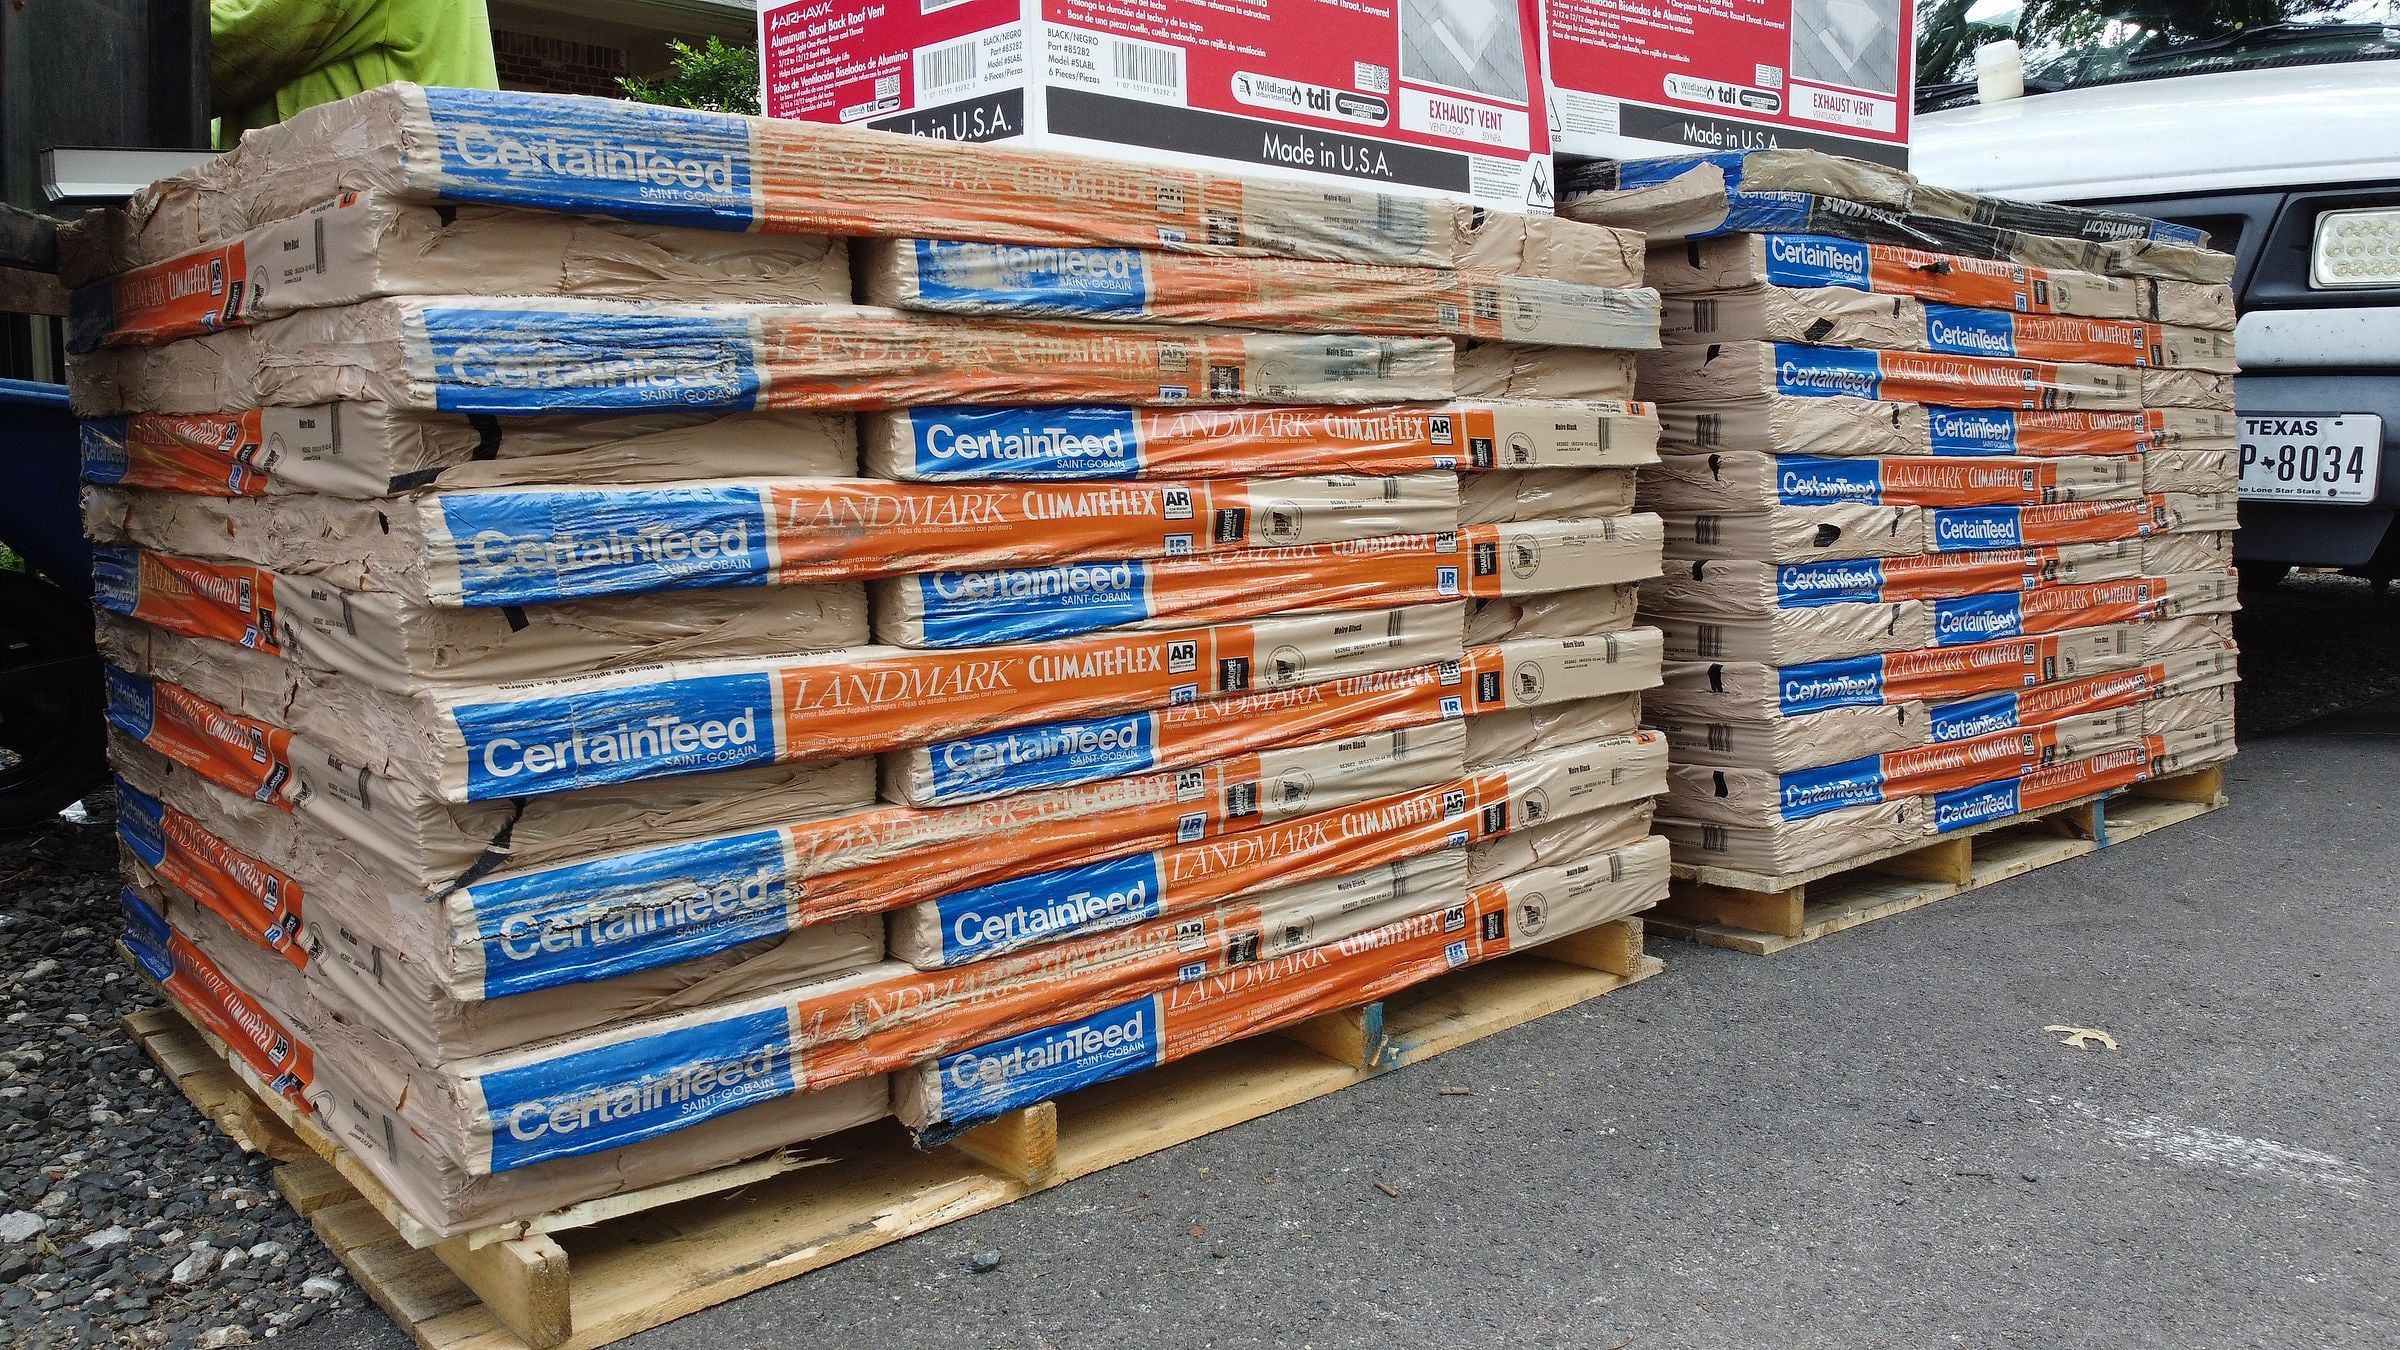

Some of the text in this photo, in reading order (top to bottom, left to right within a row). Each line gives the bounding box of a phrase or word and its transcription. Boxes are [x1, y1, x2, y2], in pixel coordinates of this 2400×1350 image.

[778, 1, 833, 28] AIRHAWK
[1098, 2, 1105, 10] la
[1106, 3, 1134, 17] duración
[1135, 8, 1146, 19] del
[1147, 11, 1164, 24] techo
[1170, 16, 1178, 26] de
[1362, 3, 1390, 18] Louvered
[1619, 1, 1693, 25] Biselados de Aluminio
[1730, 11, 1745, 21] Round
[1746, 13, 1763, 26] Throat,
[771, 4, 885, 48] Aluminum Slant Back Roof Vent
[1067, 9, 1083, 20] Base
[1085, 12, 1093, 23] de
[1095, 17, 1108, 26] una
[1152, 28, 1169, 39] cuello
[1171, 32, 1198, 45] redondo,
[1199, 38, 1209, 46] con
[1228, 42, 1236, 51] de
[983, 28, 1022, 47] BLACK/NEGRO
[1047, 28, 1099, 46] BLACK/NEGRO
[990, 47, 1001, 57] Part
[1047, 41, 1090, 57] Part #85282
[773, 83, 790, 94] Tubos
[791, 79, 800, 89] de
[800, 70, 834, 87] Ventilación
[836, 64, 866, 80] Biselados
[867, 57, 876, 68] de
[878, 51, 908, 67] Aluminio
[987, 58, 1003, 69] Model
[1048, 54, 1095, 71] Model #SLABL
[989, 67, 1023, 81] Pieces/Piezas
[1055, 69, 1100, 84] Pieces/Piezas
[1255, 80, 1292, 96] Wildland
[1680, 81, 1707, 94] Wildland
[1718, 86, 1736, 104] tdi
[866, 102, 876, 113] tdi
[1306, 87, 1331, 111] tdi
[1813, 93, 1875, 118] EXHAUST VENT
[953, 102, 1012, 141] U.S.A.
[1430, 100, 1502, 131] EXHAUST VENT
[1430, 122, 1464, 135] VENTILADOR
[1482, 132, 1490, 141] 50
[1683, 122, 1738, 148] Made in
[454, 121, 733, 194] CertainTeed
[1263, 132, 1393, 177] Made in U.S.A.
[1771, 236, 1862, 273] CertainTeed
[212, 262, 222, 281] AR
[2014, 264, 2024, 276] AR
[1060, 279, 1132, 291] SAINT-GOBAIN
[2016, 297, 2025, 309] IR
[1932, 320, 2008, 352] CertainTeed
[2016, 318, 2132, 345] LANDMARK CLIMATEFLEX
[2133, 330, 2142, 341] AR
[1886, 357, 2021, 387] LANDMARK CLIMATEFLEX
[639, 385, 742, 403] SAINT-GOBAIN
[1150, 412, 1424, 442] LANDMARK CLIMATEFLEX
[1431, 419, 1450, 433] AR
[1934, 414, 2010, 442] CertainTeed
[2245, 420, 2318, 436] TEXAS
[926, 424, 1124, 460] CertainTeed
[232, 466, 243, 482] IR
[1057, 459, 1125, 469] SAINT-GOBAIN
[2277, 444, 2364, 484] 8034
[1886, 465, 2021, 489] LANDMARK CLIMATEFLEX
[2023, 470, 2033, 482] AR
[1166, 491, 1189, 506] AR
[2238, 486, 2249, 494] he
[2251, 486, 2273, 494] Lone
[2296, 487, 2321, 495] State
[785, 489, 1157, 529] LANDMARK CLIMATEFLEX
[1223, 510, 1233, 541] SHAKOPEE
[1940, 517, 2015, 540] CertainTeed
[475, 520, 750, 568] CertainTeed
[656, 558, 751, 574] SAINT-GOBAIN
[1441, 571, 1456, 584] IR
[1061, 592, 1131, 607] SAINT-GOBAIN
[2024, 590, 2087, 612] LANDMARK
[1170, 643, 1194, 660] AR
[1887, 643, 2021, 676] LANDMARK CLIMATEFLEX
[2024, 645, 2034, 657] AR
[790, 645, 1161, 712] LANDMARK CLIMATEFLEX
[790, 711, 817, 720] Polymer
[871, 702, 897, 712] Shingles
[901, 701, 917, 710] Tejas
[1444, 701, 1458, 713] IR
[484, 707, 756, 778] CertainTeed
[944, 719, 1138, 772] CertainTeed
[2023, 734, 2033, 748] AR
[664, 743, 757, 768] SAINT-GOBAIN
[1887, 736, 2021, 779] LANDMARK CLIMATEFLEX
[1940, 790, 2013, 823] CertainTeed
[1182, 817, 1202, 831] IR
[1170, 796, 1437, 884] LANDMARK CLIMATEFLEX
[954, 881, 1146, 946] CertainTeed
[1446, 908, 1464, 925] AR
[1449, 944, 1463, 957] IR
[1184, 966, 1203, 980] IR
[951, 1010, 1143, 1090] CertainTeed
[1076, 1040, 1145, 1068] SAINT-GOBAIN
[508, 1044, 774, 1142] CertainTeed
[681, 1078, 775, 1114] SAINT-GOBAIN
